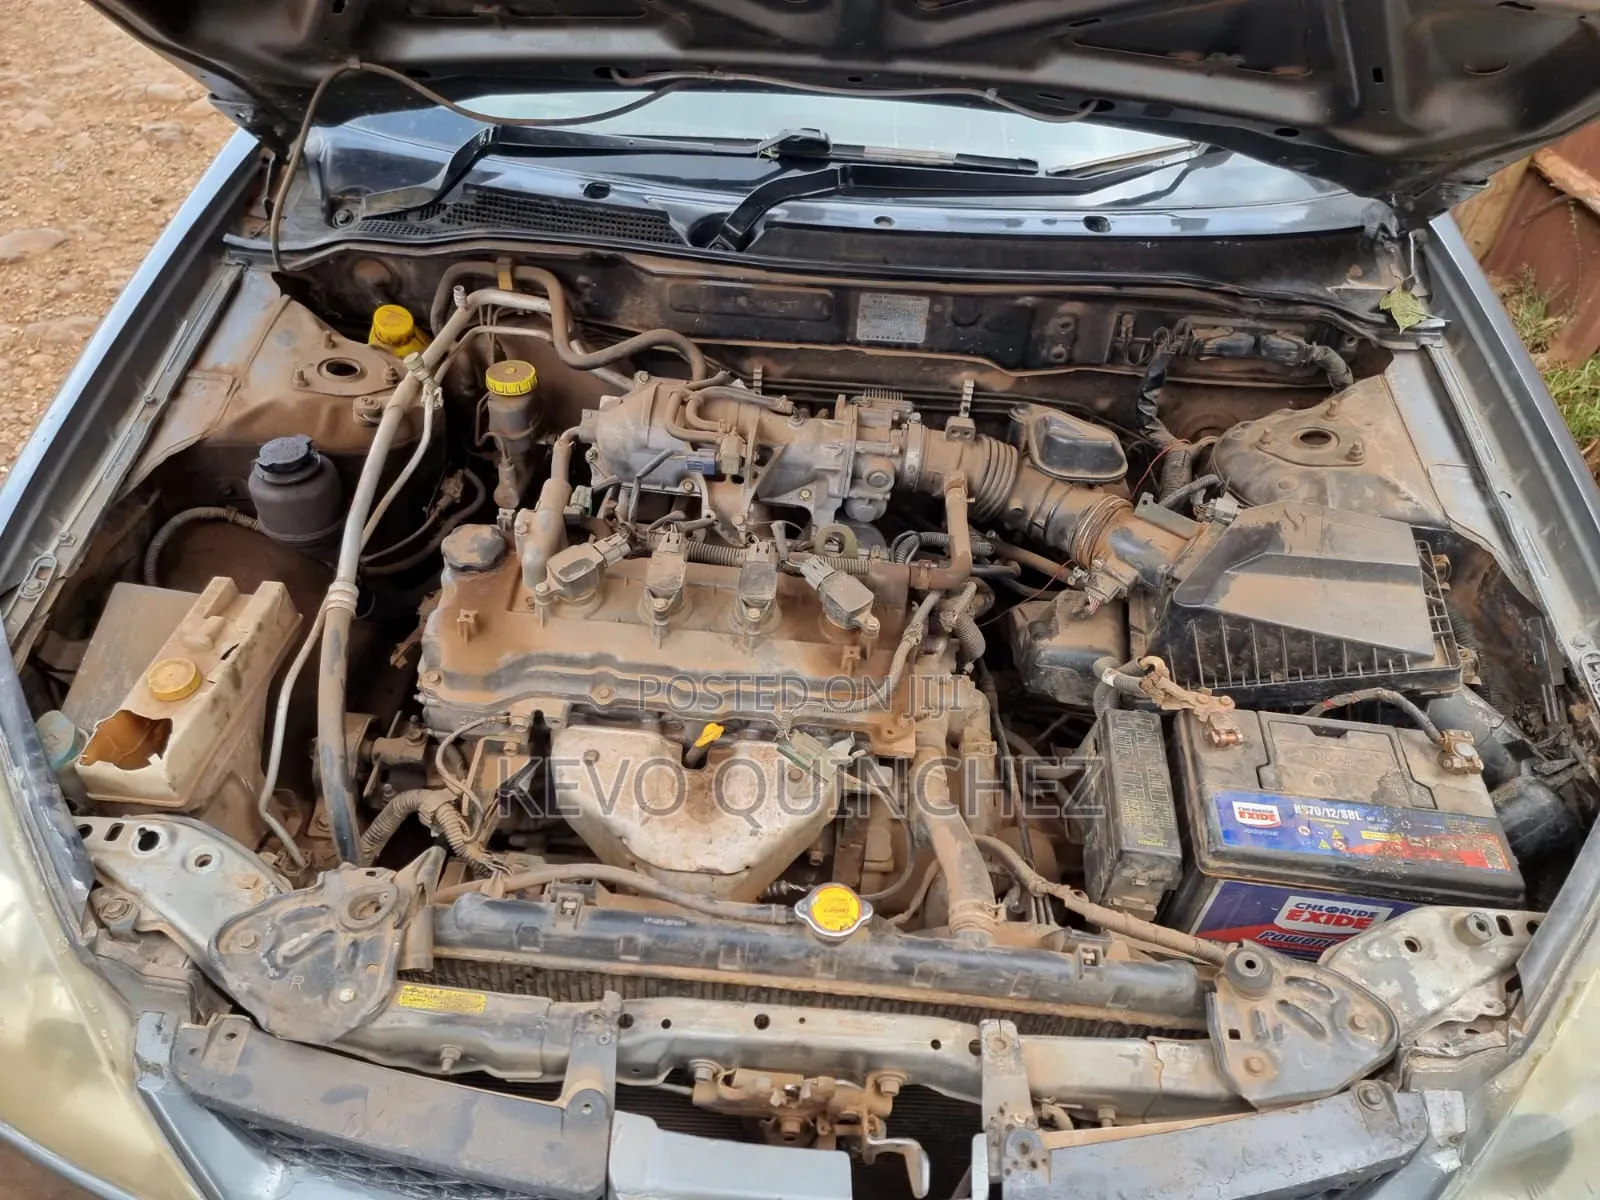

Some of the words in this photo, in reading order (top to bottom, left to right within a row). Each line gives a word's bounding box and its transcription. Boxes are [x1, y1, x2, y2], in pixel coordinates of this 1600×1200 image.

[1238, 811, 1277, 822] EXIDE
[1294, 902, 1380, 918] CHLORIDE
[1285, 909, 1376, 930] EXIDE
